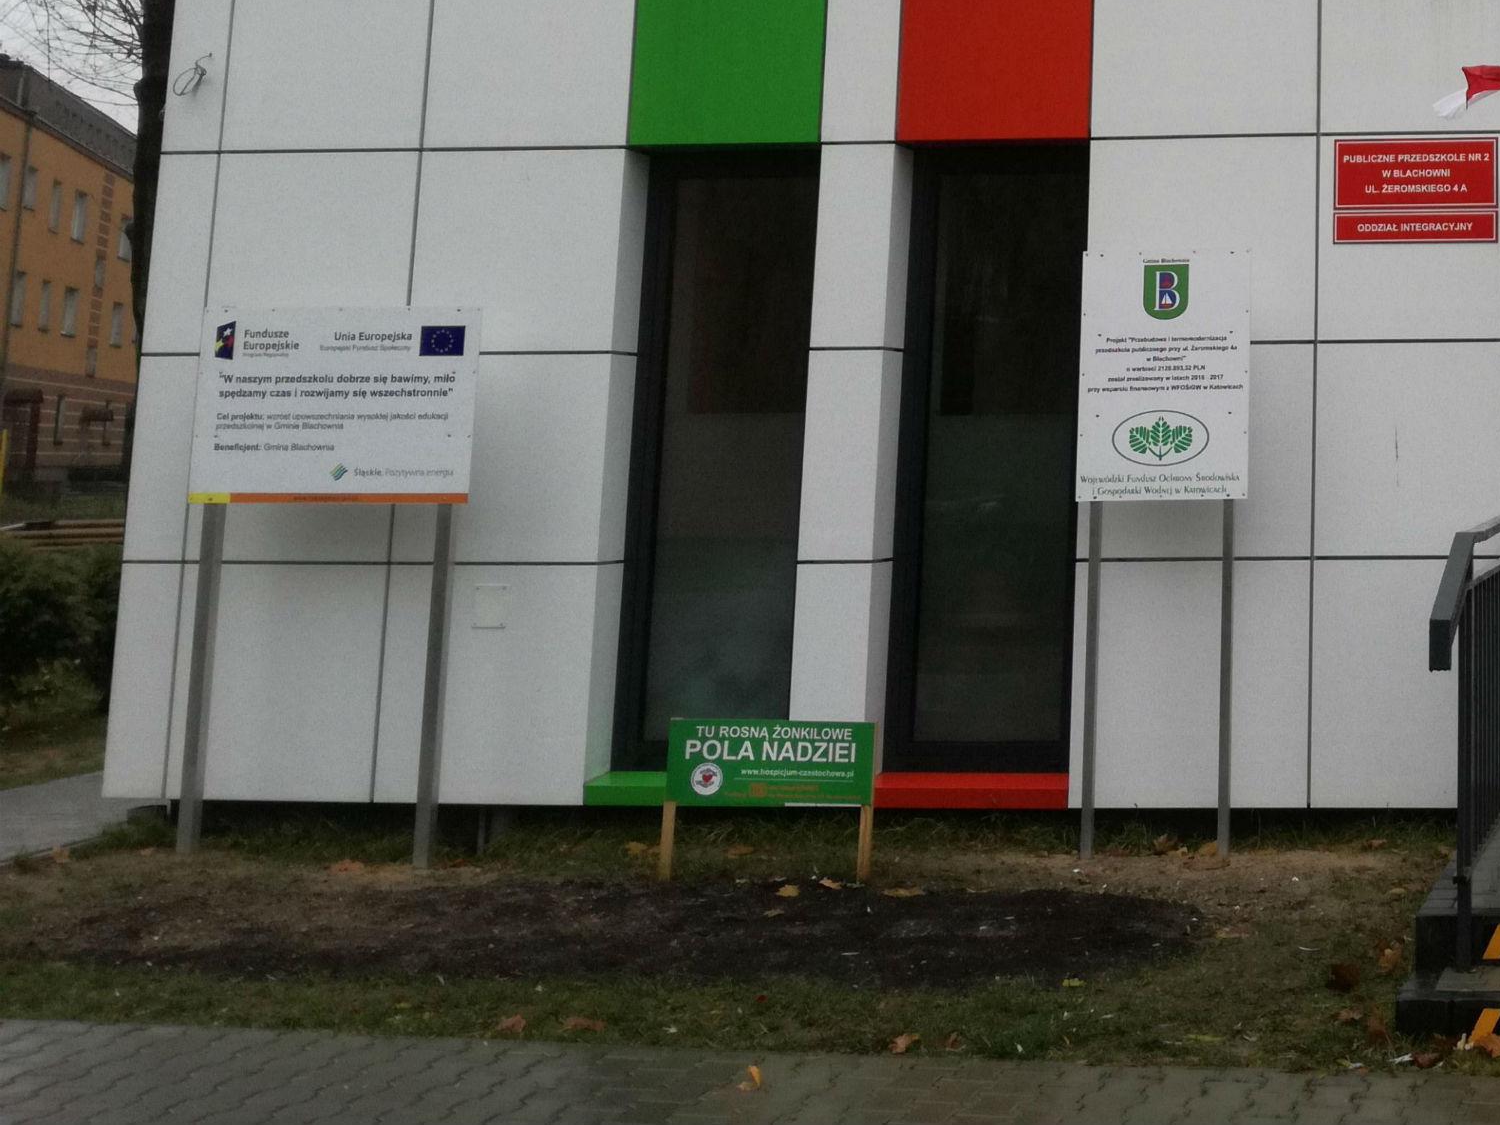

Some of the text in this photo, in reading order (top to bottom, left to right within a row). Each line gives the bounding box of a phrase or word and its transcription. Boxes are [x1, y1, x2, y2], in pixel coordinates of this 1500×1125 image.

[1344, 154, 1395, 163] PUBLICZNE
[1398, 154, 1466, 162] PRZEDSZKOLE
[1382, 169, 1450, 178] W BLACHOWNI
[1365, 183, 1467, 193] UL. ŻEROMSKIEGO 4 A
[1357, 222, 1473, 232] ODDZIAŁ INTEGRACYJNY
[244, 329, 289, 338] Fundusze
[334, 332, 412, 342] Unia Europejska
[243, 341, 300, 351] Europejskie
[236, 376, 272, 385] naszym
[275, 375, 333, 385] przedszkolu
[337, 375, 370, 383] dobrze
[374, 374, 388, 385] się
[391, 374, 430, 385] bawimy,
[434, 374, 455, 383] miło
[219, 389, 267, 399] spędzamy
[295, 389, 297, 397] i
[300, 389, 349, 399] rozwijamy
[353, 389, 367, 399] się
[696, 724, 853, 740] TU ROSNĄ ŻONKILOWE
[685, 740, 856, 763] POLA NADZIEI
